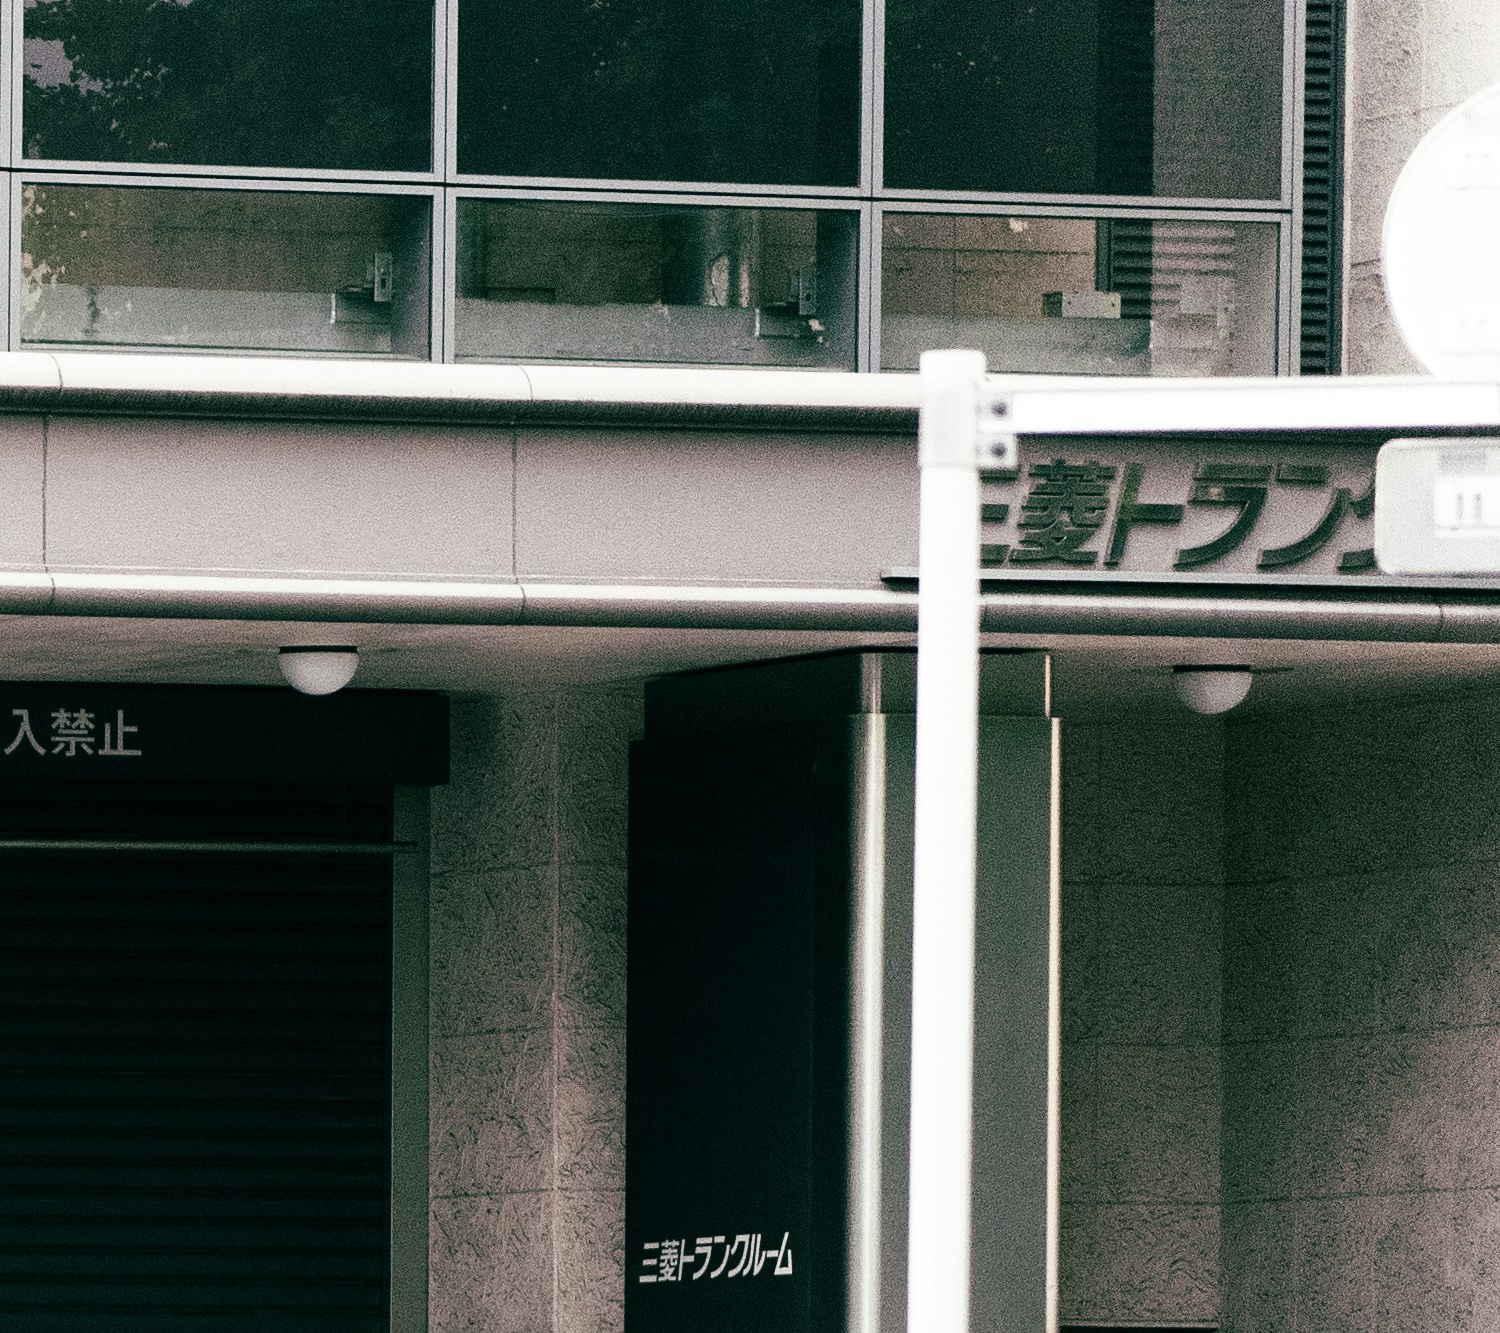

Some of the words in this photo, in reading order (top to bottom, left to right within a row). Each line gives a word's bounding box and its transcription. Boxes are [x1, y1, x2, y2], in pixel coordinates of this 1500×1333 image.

[638, 1231, 794, 1284] 三菱トランクルーム
